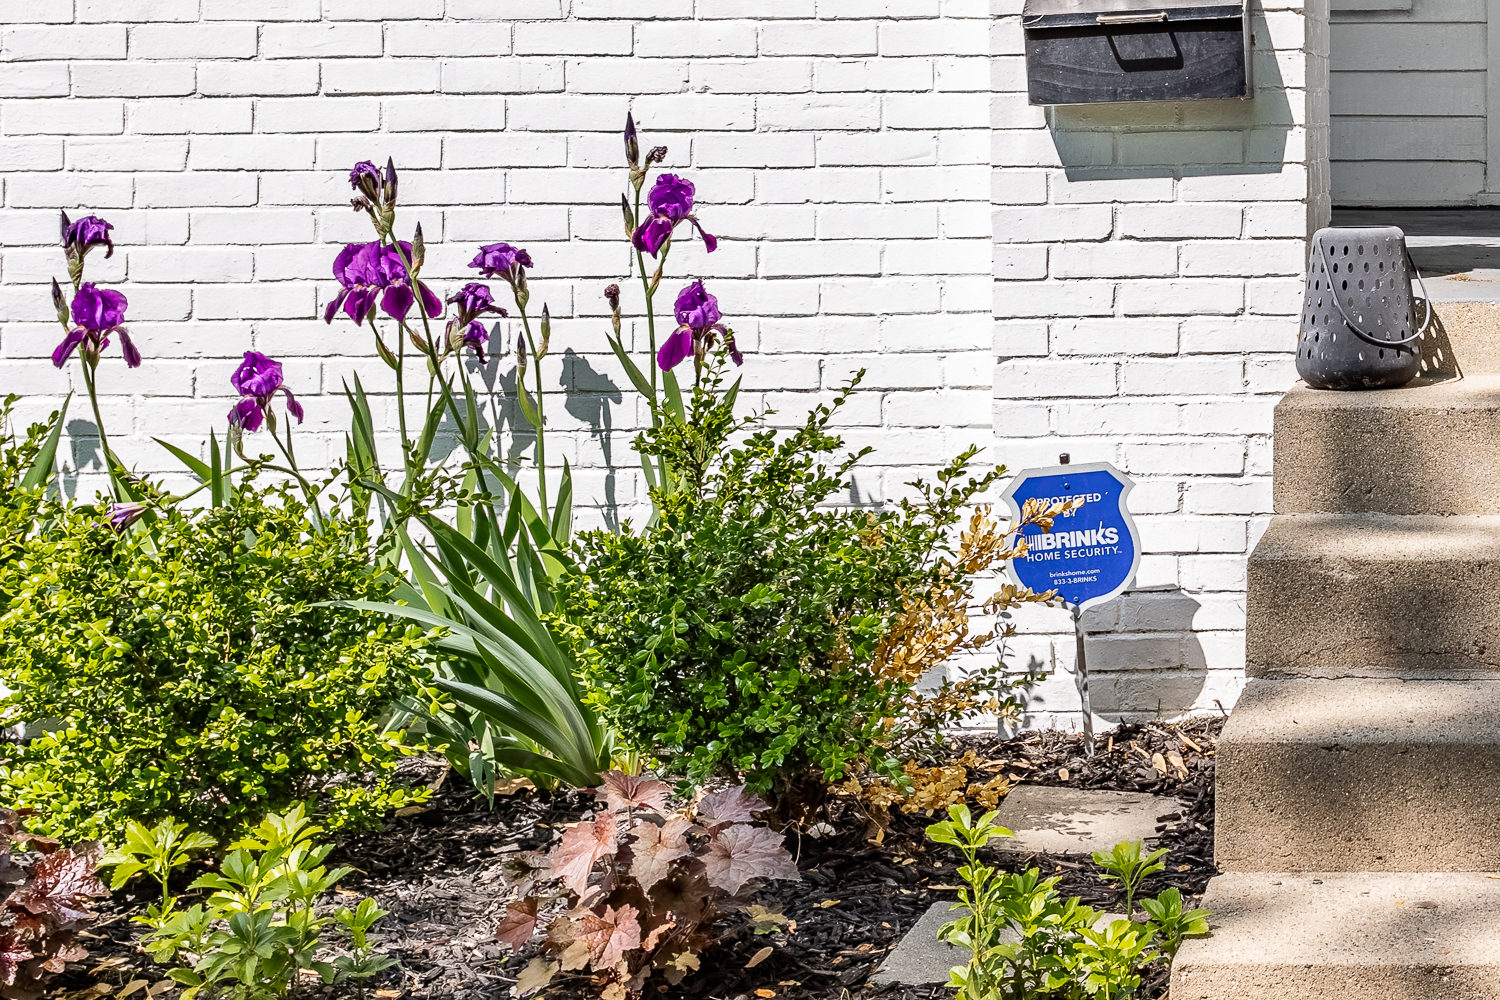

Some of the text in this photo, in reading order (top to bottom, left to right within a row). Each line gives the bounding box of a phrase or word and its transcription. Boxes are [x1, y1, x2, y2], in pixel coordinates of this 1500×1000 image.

[1042, 521, 1119, 550] BRINKS
[1027, 551, 1061, 562] HOME
[1049, 569, 1100, 578] brinkshome.com
[1053, 576, 1098, 585] 833-3-BRINKS
